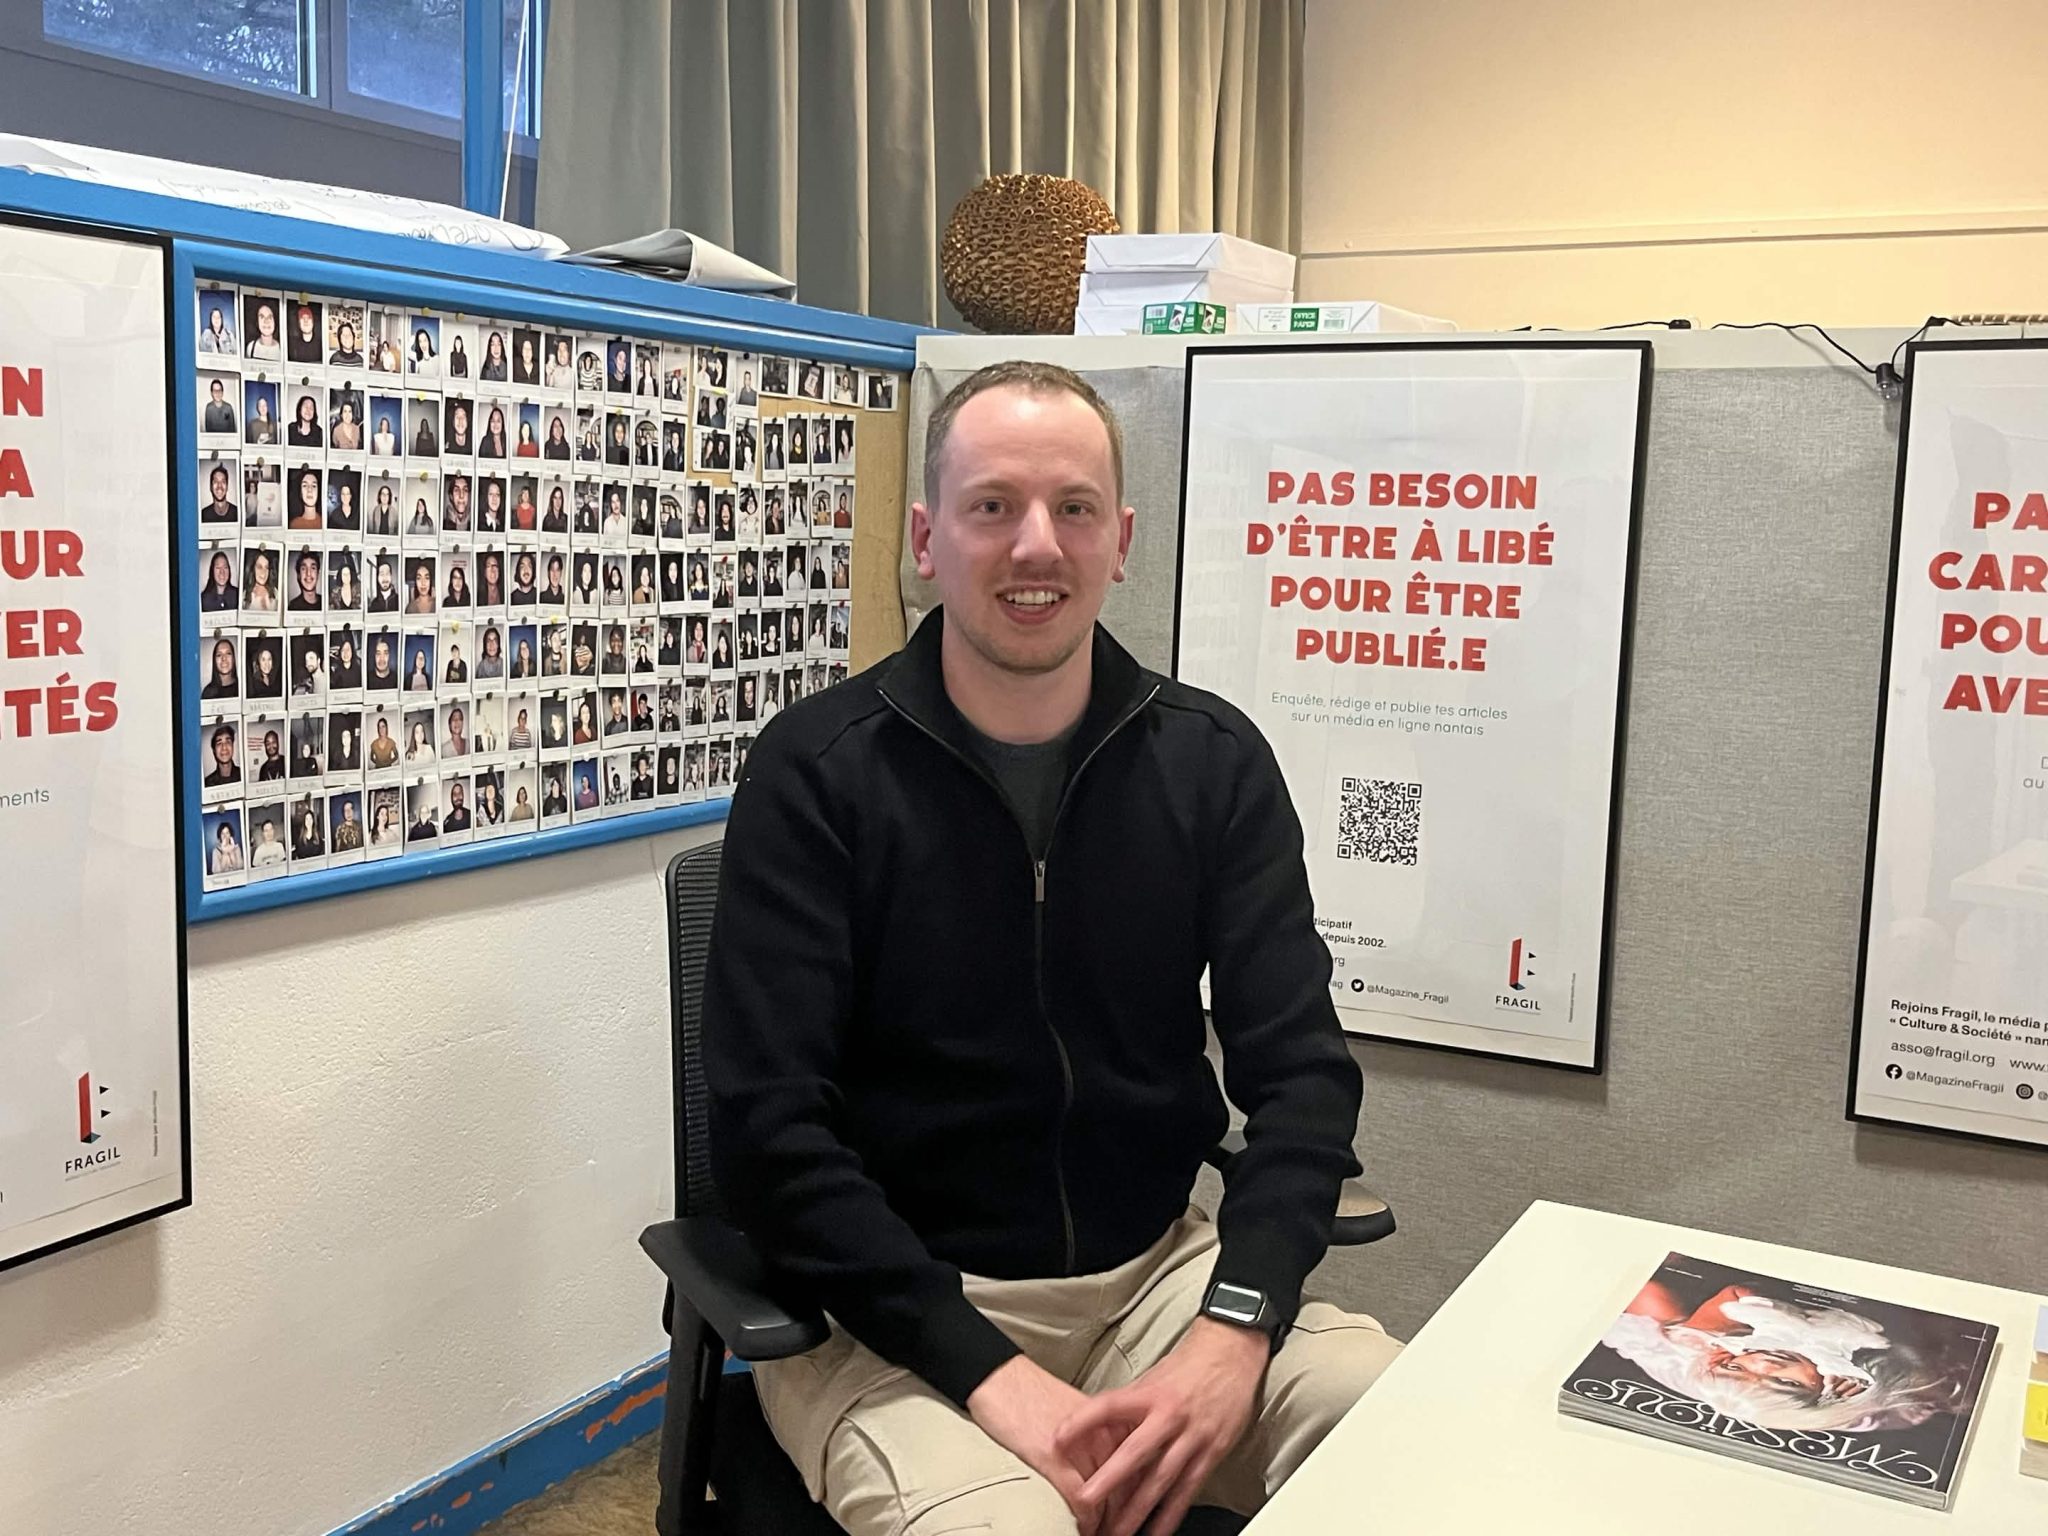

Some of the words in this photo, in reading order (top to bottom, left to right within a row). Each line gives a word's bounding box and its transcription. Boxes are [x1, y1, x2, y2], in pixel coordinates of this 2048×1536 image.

[1268, 471, 1355, 506] PAS
[1369, 473, 1537, 509] BESOIN
[1247, 514, 1397, 560] D'ÊTRE
[1410, 518, 1443, 562] À
[1457, 522, 1555, 566] LIBÉ
[1928, 551, 2048, 593] CAR
[1270, 575, 1392, 613] POUR
[1406, 571, 1522, 619] ÊTRE
[0, 608, 85, 659] ER
[1296, 627, 1487, 672] PUBLIÉ.E
[0, 672, 119, 738] TÉS
[1271, 692, 1328, 708] Enquête,
[1330, 696, 1371, 712] rédige
[1374, 700, 1387, 711] et
[1390, 701, 1432, 714] publie
[1435, 705, 1455, 717] tes
[1458, 706, 1508, 720] articles
[1291, 712, 1310, 722] sur
[1314, 713, 1330, 723] un
[1333, 714, 1374, 728] média
[1378, 718, 1394, 729] en
[1398, 718, 1431, 733] ligne
[1434, 722, 1484, 736] nantais
[2023, 778, 2044, 789] au
[1322, 932, 1356, 945] depuis
[1357, 936, 1387, 948] 2002.
[1329, 980, 1343, 990] ag
[1367, 984, 1449, 1004] @Magazine_Fragil
[1495, 995, 1541, 1011] FRAGIL
[1891, 999, 1939, 1015] Rejoins
[1941, 1006, 1981, 1023] Fragil,
[1984, 1012, 1996, 1023] le
[1998, 1015, 2041, 1029] média
[1899, 1016, 1947, 1032] Culture
[1950, 1023, 1960, 1034] &
[1961, 1025, 2012, 1041] Société
[1891, 1042, 1996, 1068] asso@fragil.org
[1905, 1070, 2004, 1094] @MagazineFragil
[65, 1147, 121, 1174] FRAGIL
